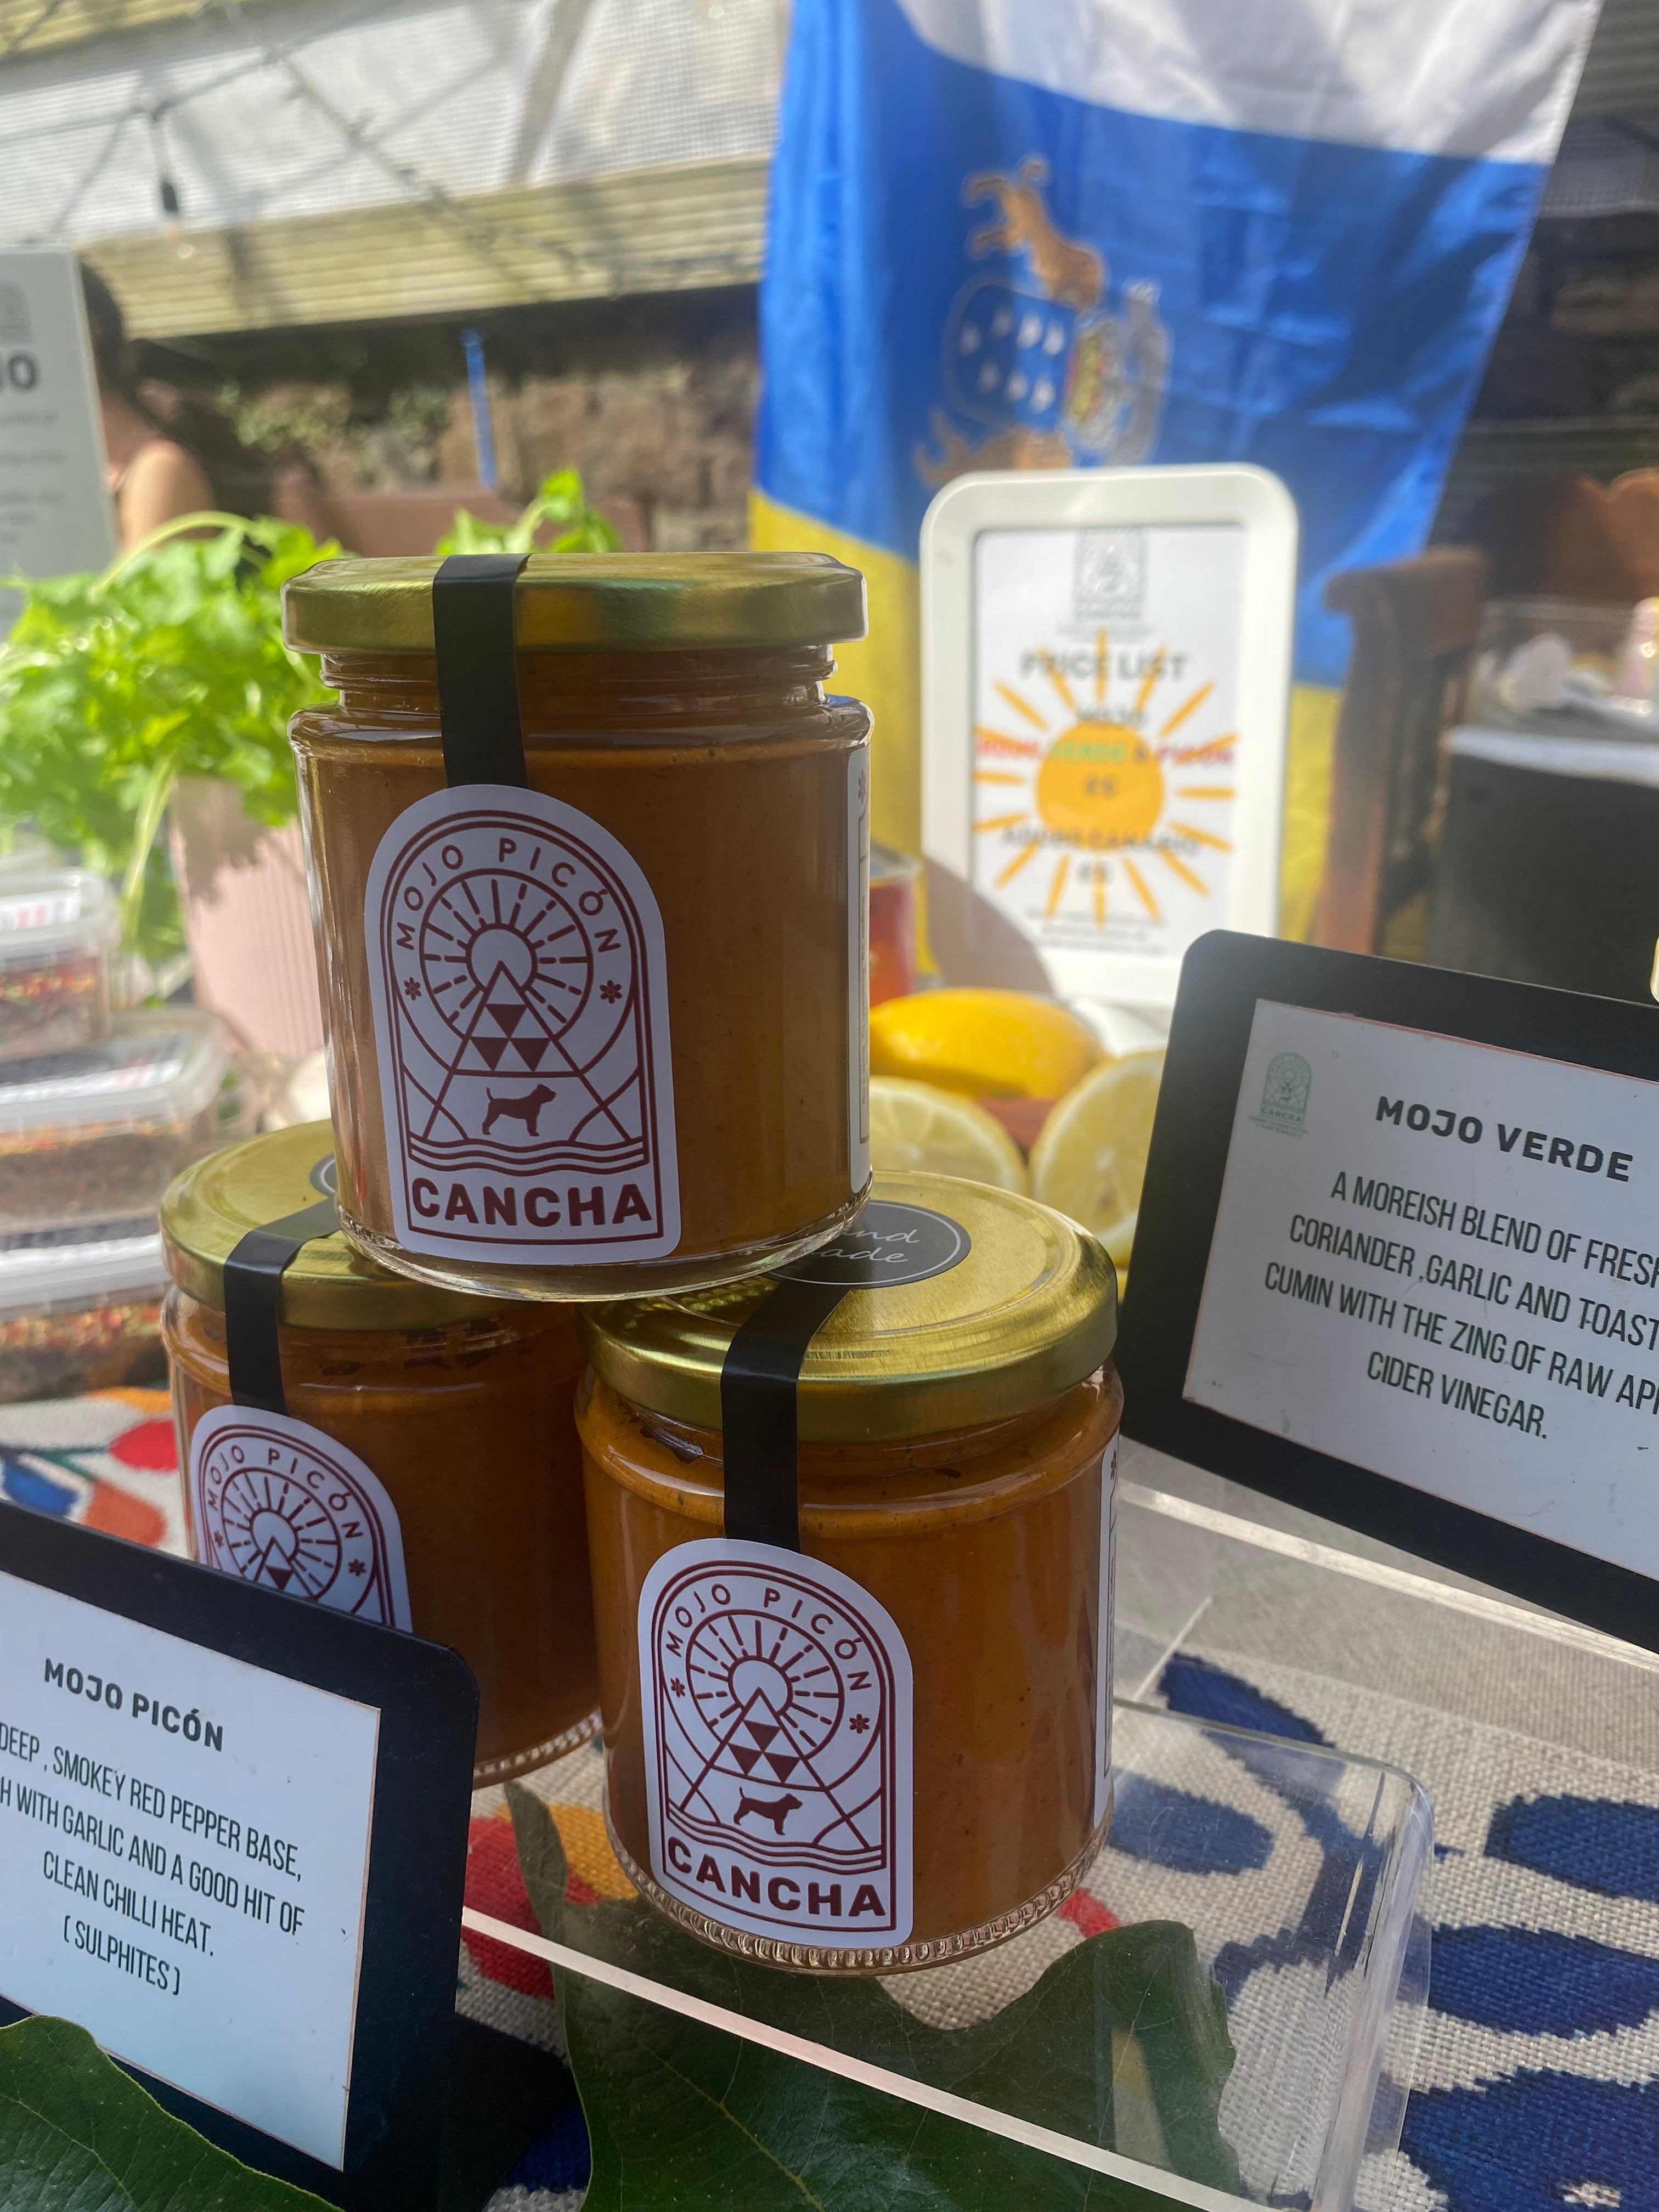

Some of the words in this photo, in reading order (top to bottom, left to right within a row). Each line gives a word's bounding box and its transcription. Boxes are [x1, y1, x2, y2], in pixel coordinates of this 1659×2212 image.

[1019, 651, 1110, 680] PRICE
[1117, 651, 1189, 680] LIST
[396, 844, 464, 950] MOJO
[498, 837, 622, 954] PICÓN
[1261, 1105, 1302, 1122] CANCHA
[1376, 1097, 1482, 1144] MOJO
[1497, 1124, 1633, 1182] VERDE
[411, 1177, 652, 1228] CANCHA
[844, 1229, 921, 1244] nd
[1331, 1172, 1346, 1201] A
[1353, 1176, 1457, 1231] MOREISH
[1461, 1205, 1542, 1254] BLEND
[1547, 1229, 1582, 1263] OF
[812, 1246, 909, 1263] ade
[1290, 1215, 1415, 1277] CORIANDER
[1515, 1282, 1571, 1323] AND
[1265, 1262, 1334, 1308] CUMIN
[1340, 1284, 1397, 1329] WITH
[1403, 1304, 1448, 1345] THE
[1449, 1320, 1507, 1364] ZING
[1510, 1340, 1546, 1374] OF
[1548, 1351, 1614, 1398] RAW
[1367, 1352, 1434, 1400] CIDER
[1442, 1374, 1547, 1440] VINEGAR.
[207, 1444, 245, 1512] MOJO
[267, 1448, 364, 1539] PICÓN
[665, 1582, 731, 1657] MOJO
[764, 1587, 873, 1691] PICÓN
[44, 1658, 123, 1710] MOJO
[132, 1692, 223, 1752] PICÓN
[0, 1722, 40, 1763] DEEP
[53, 1746, 126, 1801] SMOKEY
[130, 1778, 165, 1819] RED
[171, 1795, 241, 1853] PEPPER
[246, 1827, 301, 1883] BASE,
[17, 1784, 59, 1829] WITH
[63, 1805, 124, 1857] GARLIC
[128, 1835, 167, 1876] AND
[171, 1854, 183, 1885] A
[189, 1861, 239, 1909] GOOD
[244, 1884, 276, 1924] HIT
[280, 1901, 305, 1936] OF
[44, 1851, 99, 1901] CLEAN
[104, 1878, 157, 1929] CHILLI
[162, 1905, 214, 1957] HEAT.
[667, 1836, 887, 1917] CANCHA
